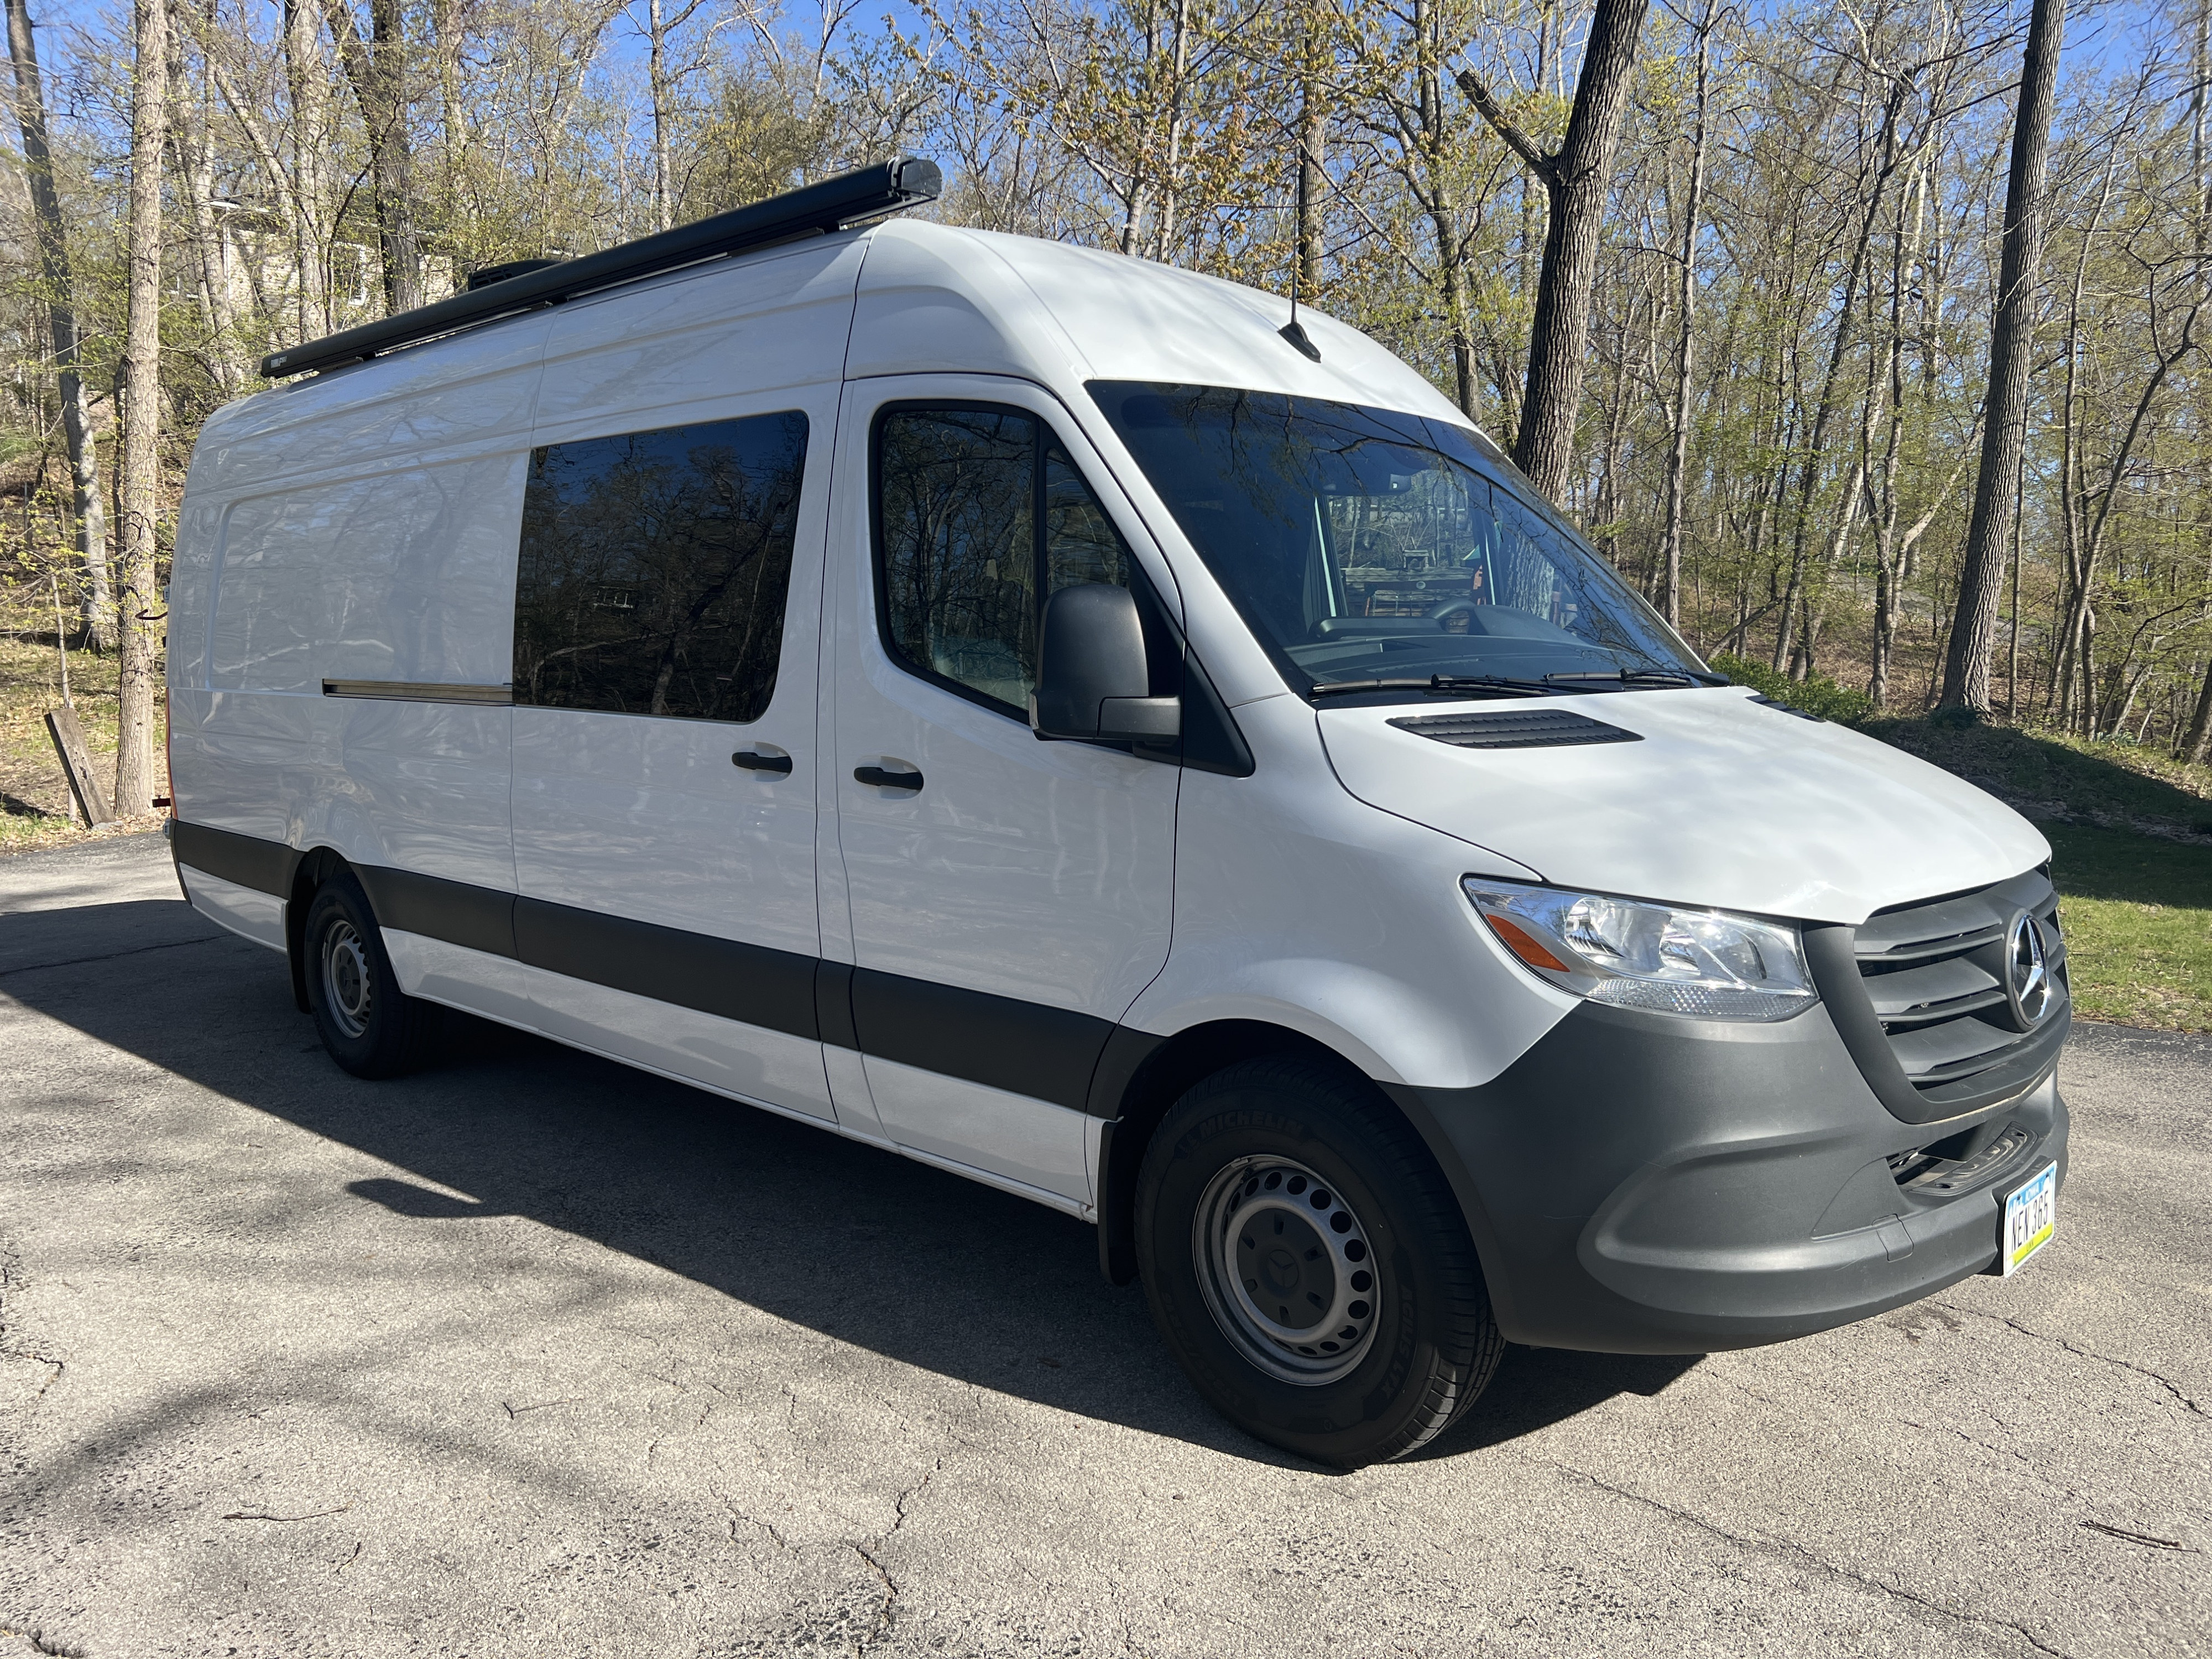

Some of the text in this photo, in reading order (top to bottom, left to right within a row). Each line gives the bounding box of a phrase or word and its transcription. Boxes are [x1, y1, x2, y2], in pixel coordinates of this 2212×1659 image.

[1199, 1110, 1305, 1139] MICHELIN
[2025, 1183, 2039, 1202] IOWA
[2012, 1191, 2048, 1251] NEN 365
[1381, 1284, 1415, 1400] AGILIS LTX
